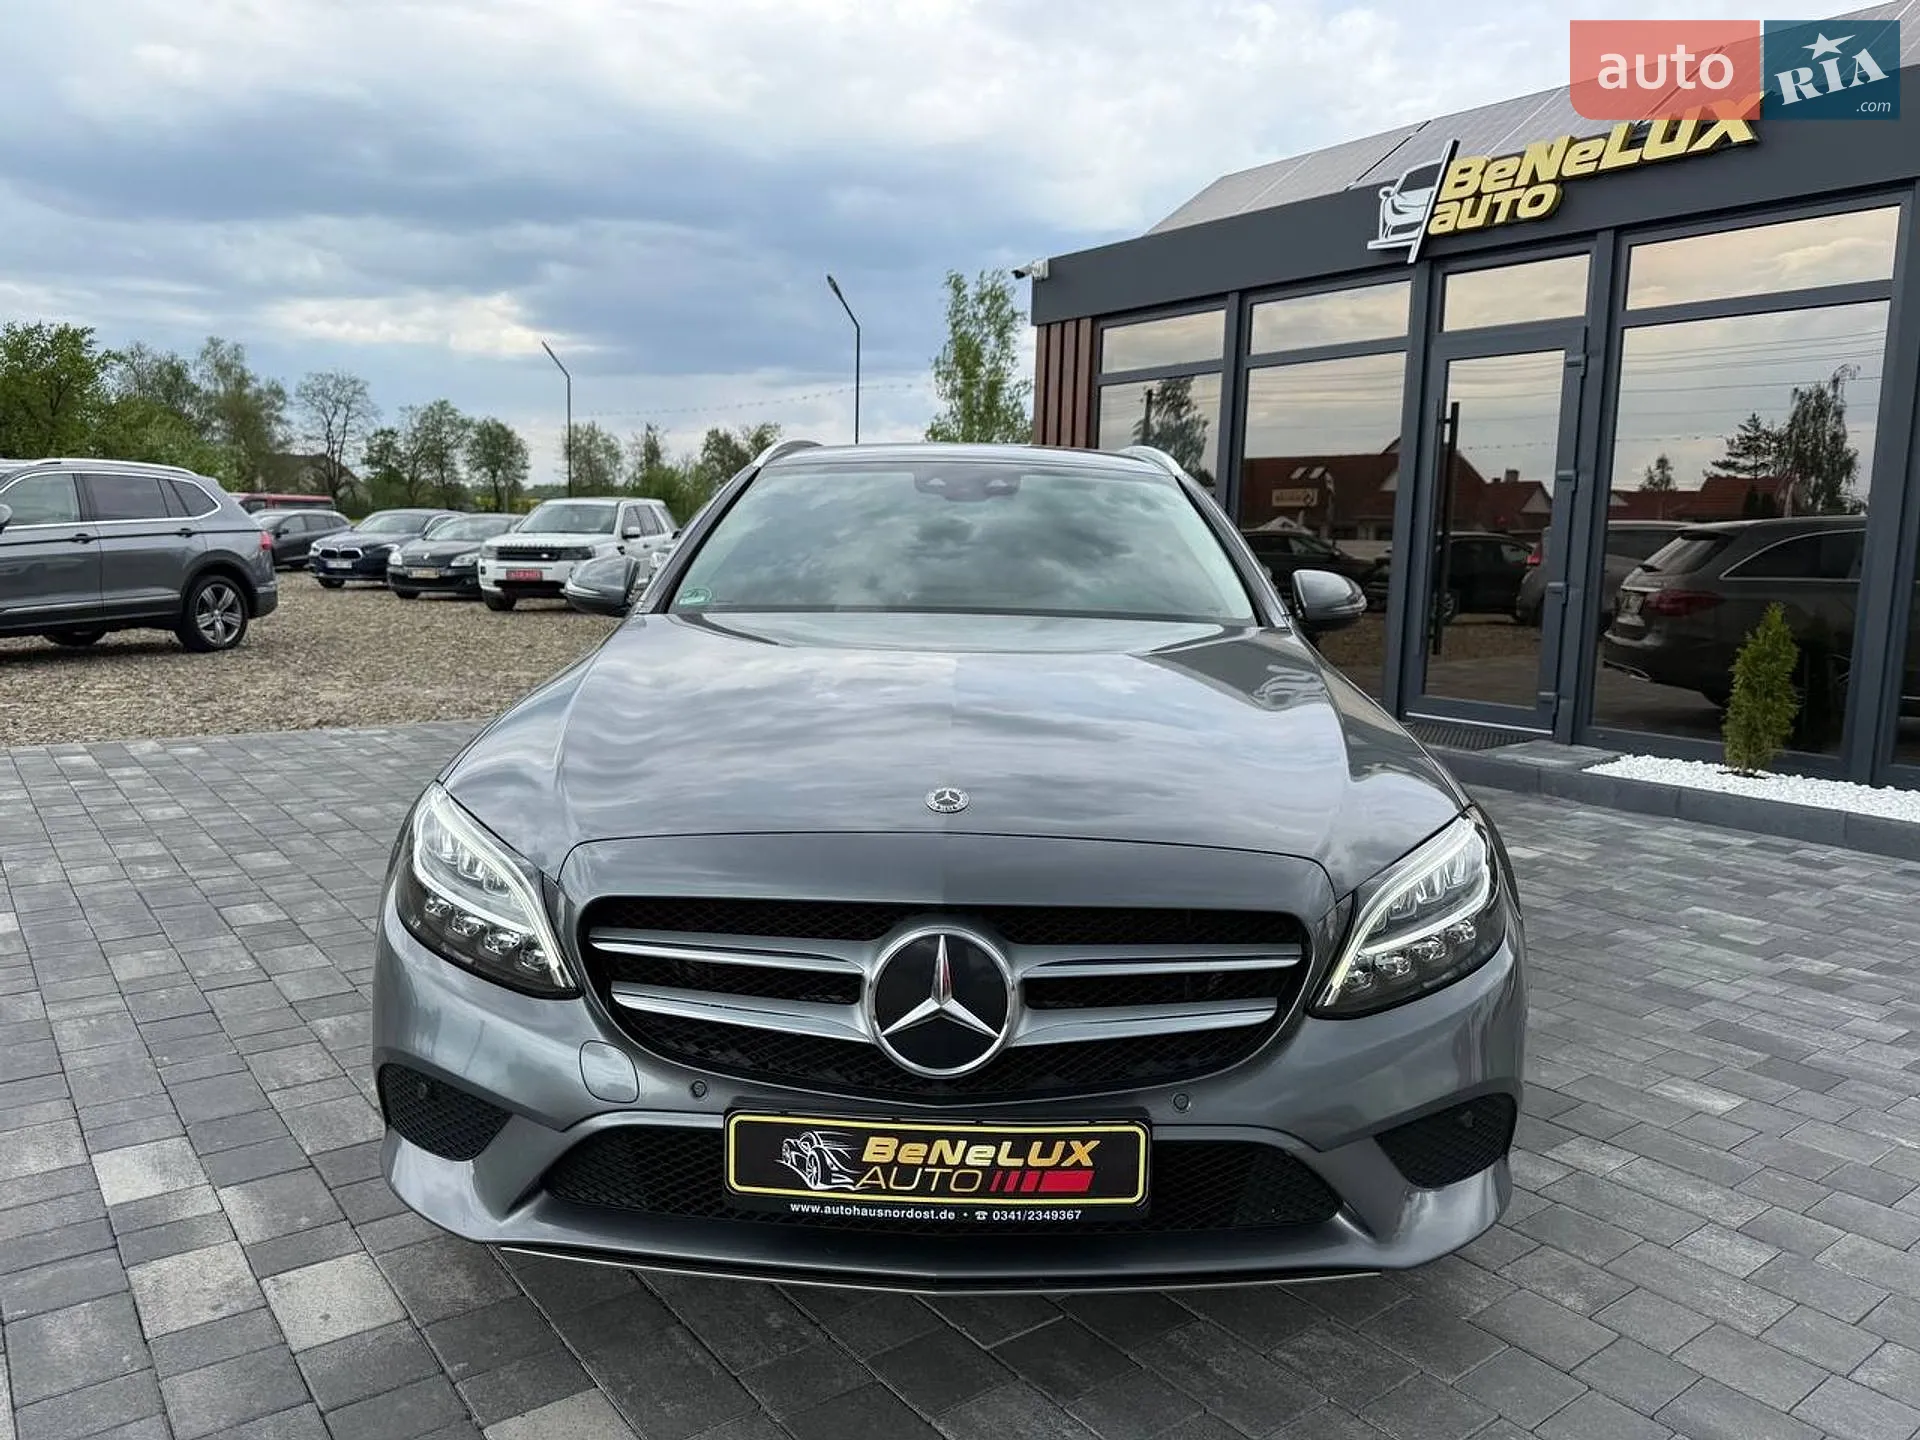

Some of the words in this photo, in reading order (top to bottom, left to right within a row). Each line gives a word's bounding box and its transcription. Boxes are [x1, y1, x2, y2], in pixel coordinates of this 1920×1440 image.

[1439, 92, 1763, 200] BeNeLUX
[861, 1136, 1100, 1167] BeNeLUX
[855, 1165, 983, 1193] AUTO
[789, 1202, 956, 1220] www.autohausnordost.de
[992, 1209, 1082, 1222] 0341/2349367
